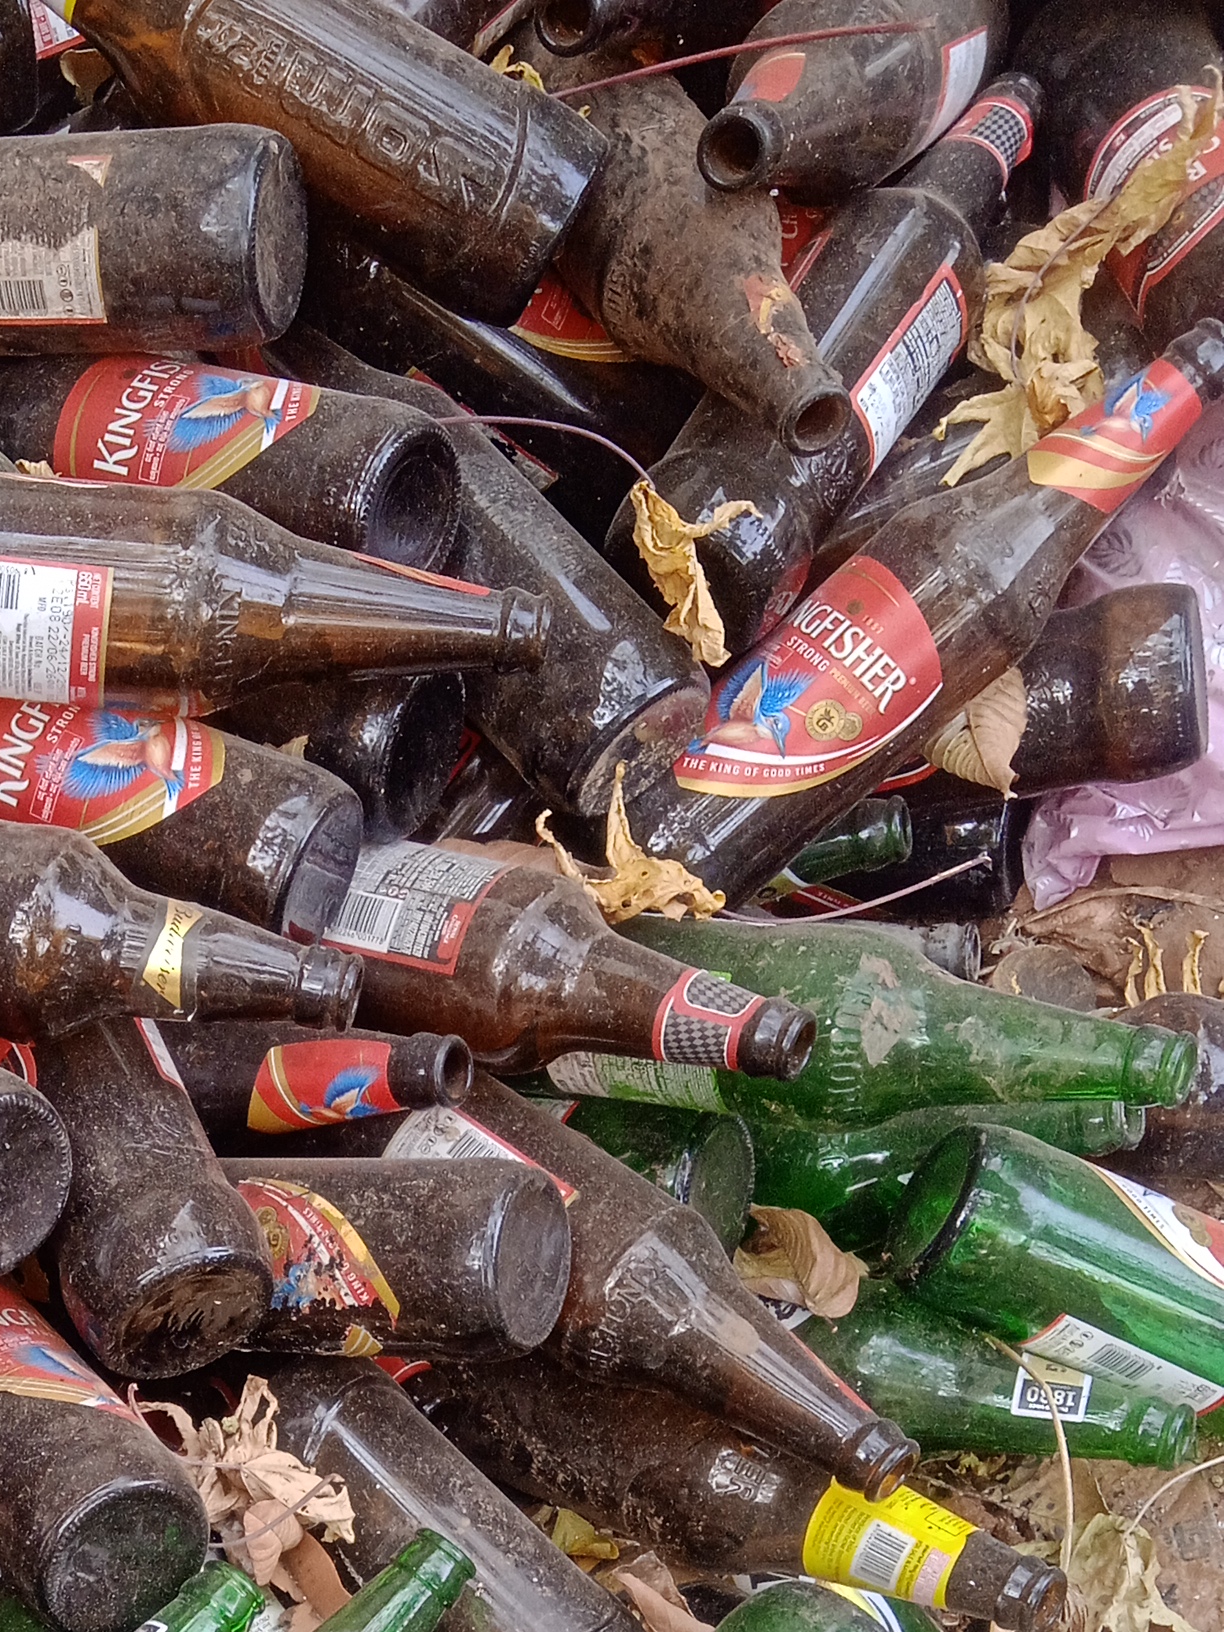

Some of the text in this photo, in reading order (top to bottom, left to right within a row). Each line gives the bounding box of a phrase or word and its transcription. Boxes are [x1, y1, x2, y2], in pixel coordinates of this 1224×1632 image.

[784, 631, 832, 674] STRONG
[188, 742, 201, 788] THE KING
[682, 755, 826, 780] THE KING OF GOOD TIMES
[154, 902, 193, 996] Budiser
